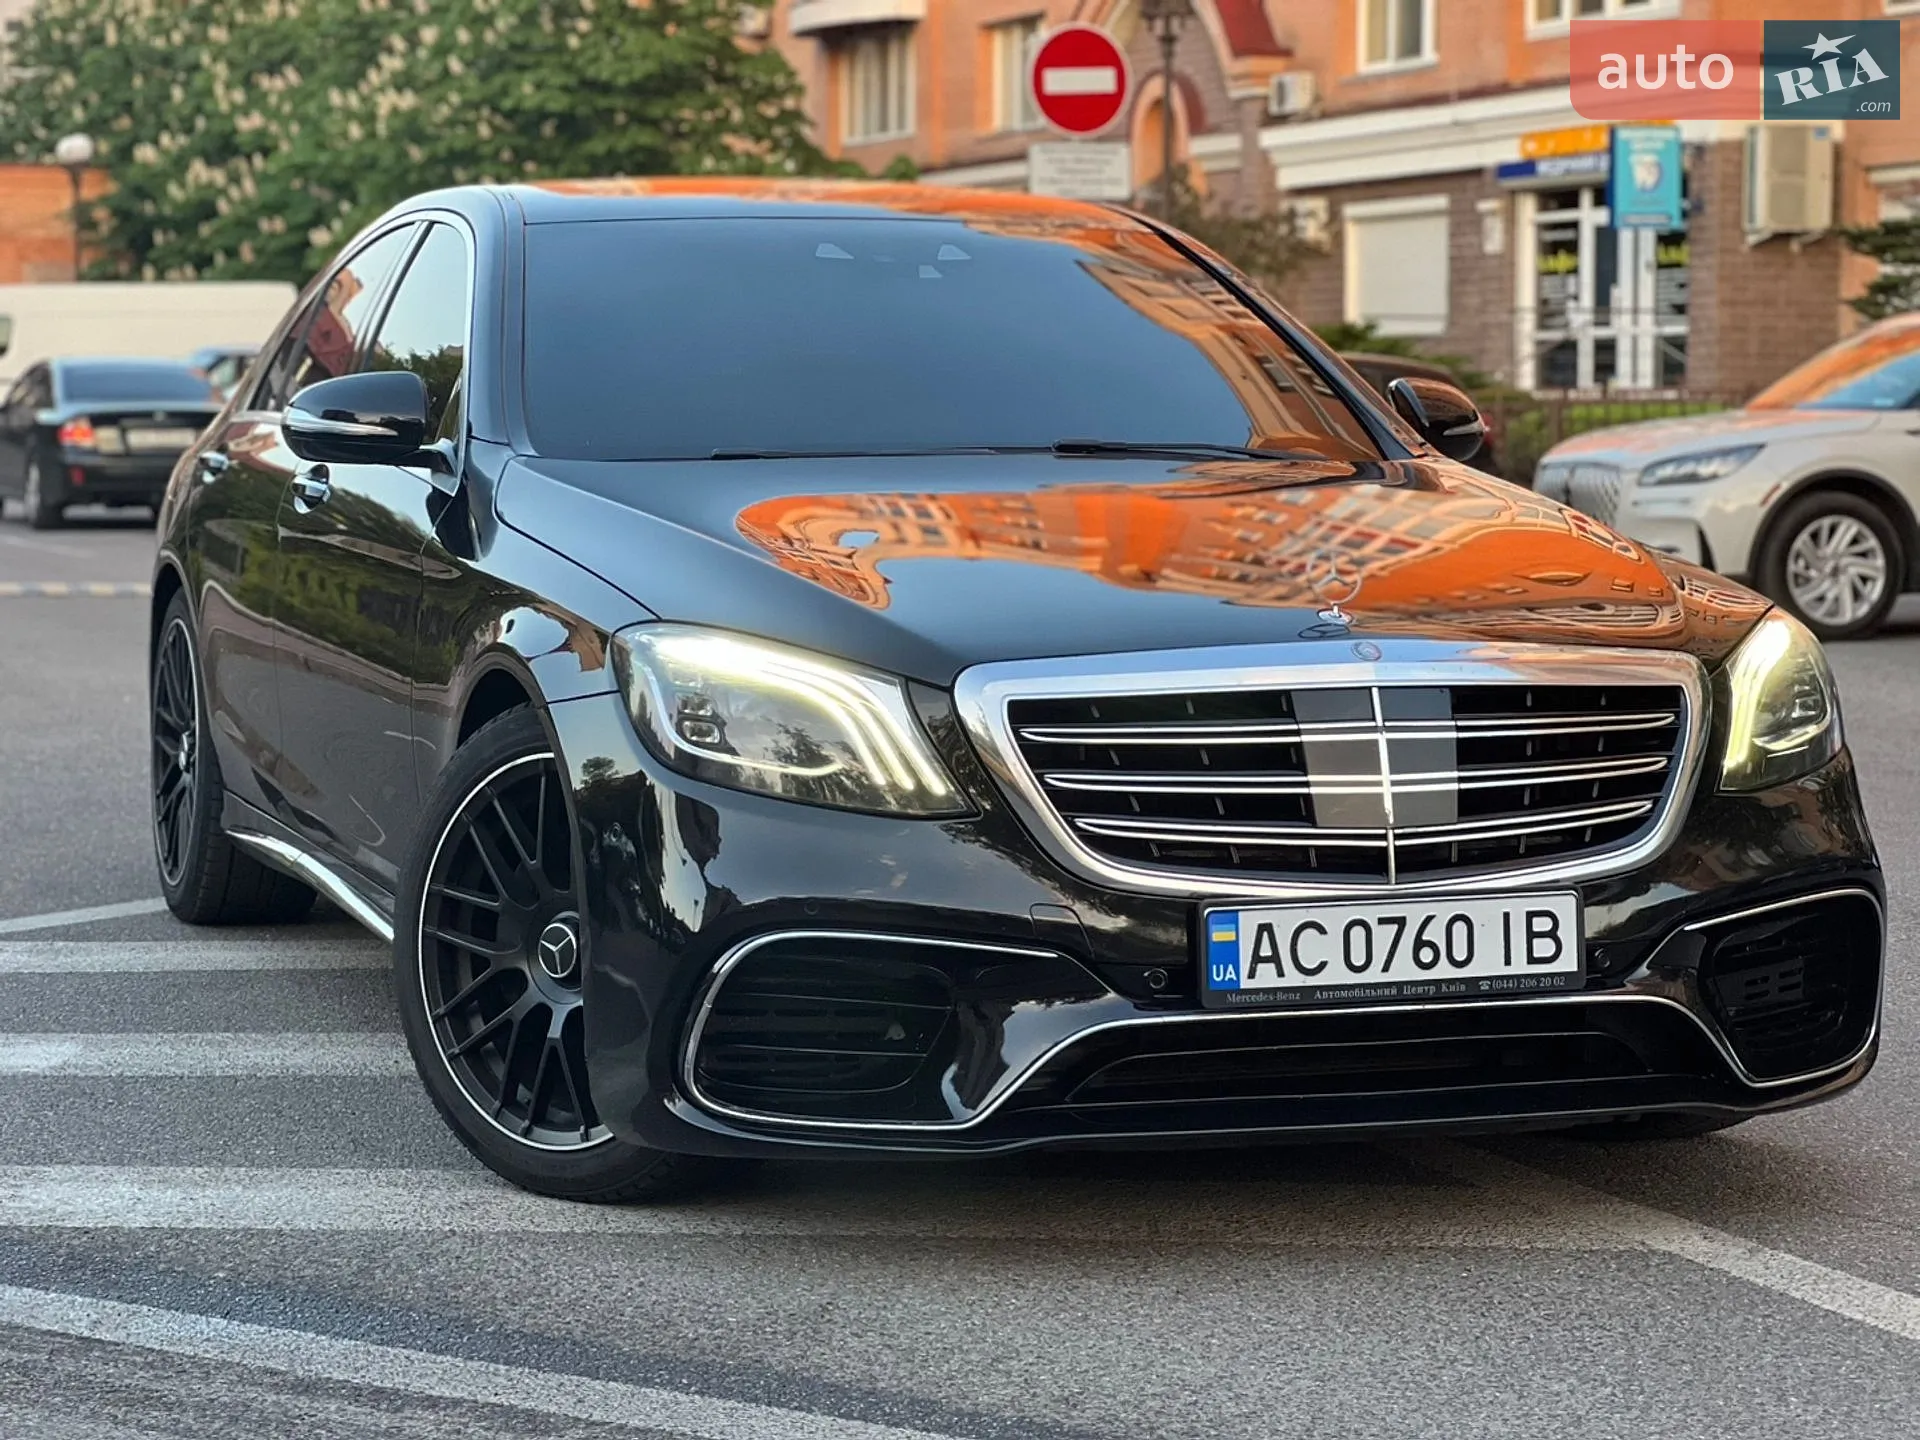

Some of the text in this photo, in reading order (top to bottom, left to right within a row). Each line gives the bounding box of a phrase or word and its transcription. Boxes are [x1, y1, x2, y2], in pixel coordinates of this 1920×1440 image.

[1247, 909, 1563, 980] AC 0760 IB
[1212, 964, 1238, 981] UA
[1226, 992, 1301, 1003] Mercedes-Benz
[1314, 986, 1398, 1000] Автомобільний
[1403, 984, 1437, 996] Центр
[1492, 978, 1518, 990] (044)
[1519, 978, 1538, 988] 206
[1539, 977, 1552, 987] 20
[1553, 976, 1566, 986] 02
